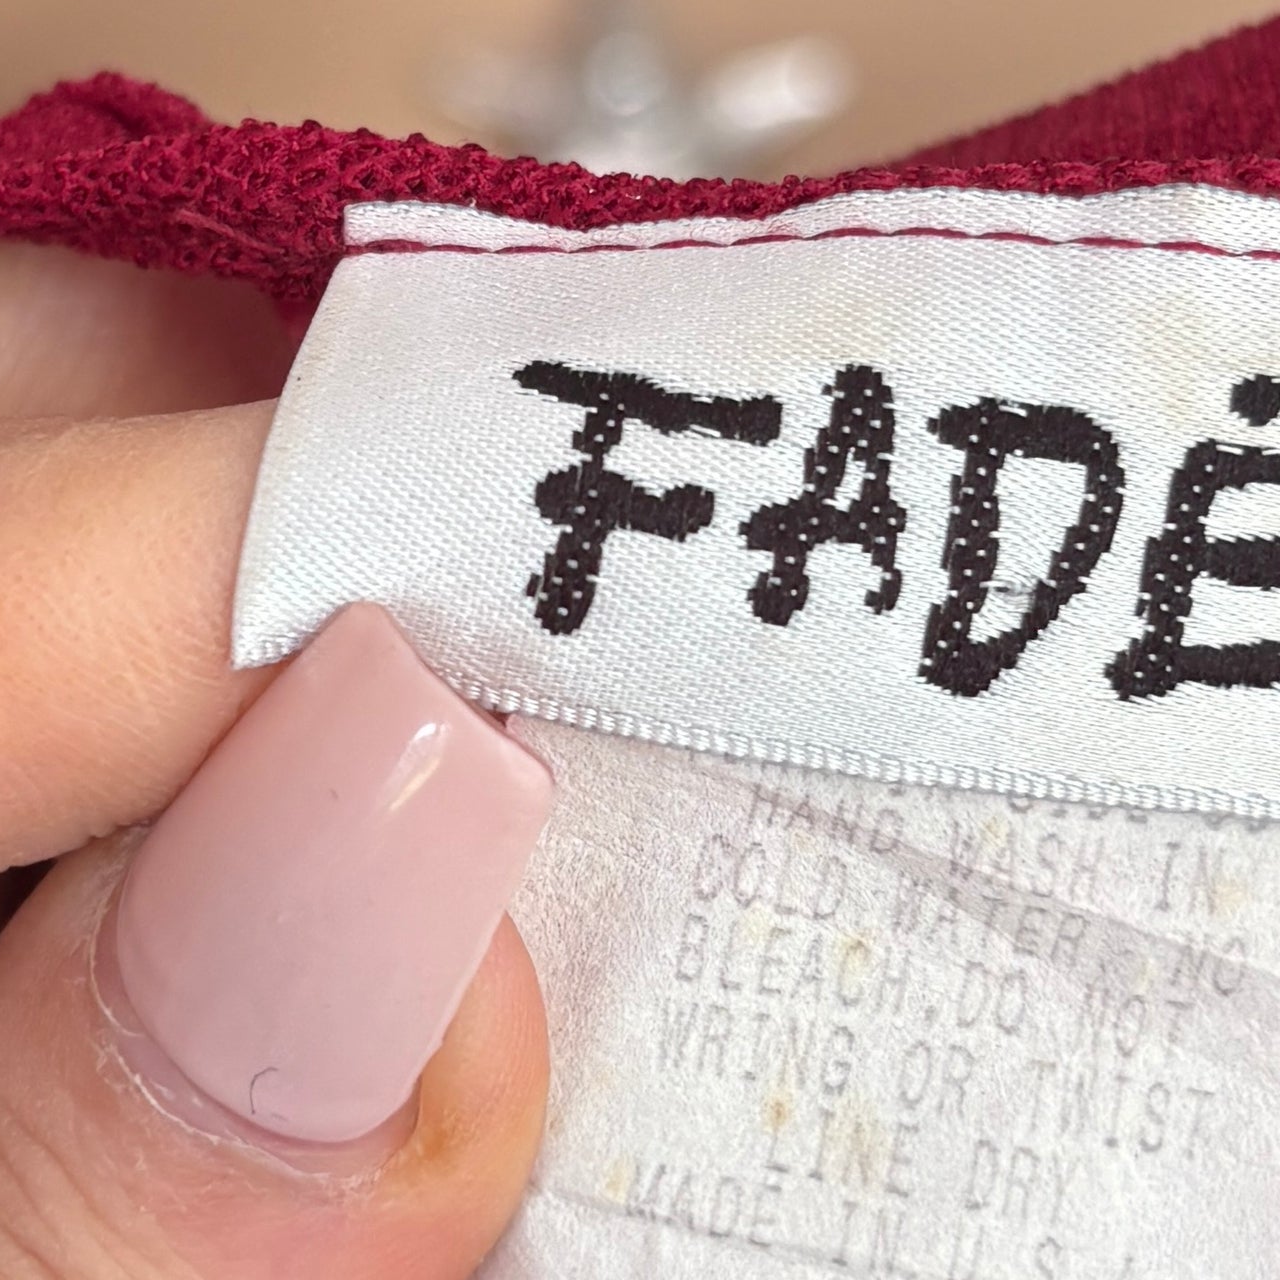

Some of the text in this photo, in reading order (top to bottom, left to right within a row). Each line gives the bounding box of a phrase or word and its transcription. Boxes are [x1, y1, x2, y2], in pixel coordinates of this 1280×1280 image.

[749, 783, 904, 855] HAND
[947, 820, 1101, 904] WASH
[1154, 840, 1228, 915] IN
[692, 832, 848, 922] COLD
[1168, 935, 1248, 998] NO
[658, 1002, 1216, 1160] WRING OR TWIST
[1075, 982, 1194, 1060] NOT
[624, 1160, 784, 1252] MADE
[829, 1198, 910, 1274] IN
[764, 1100, 1082, 1226] LINE DRY
